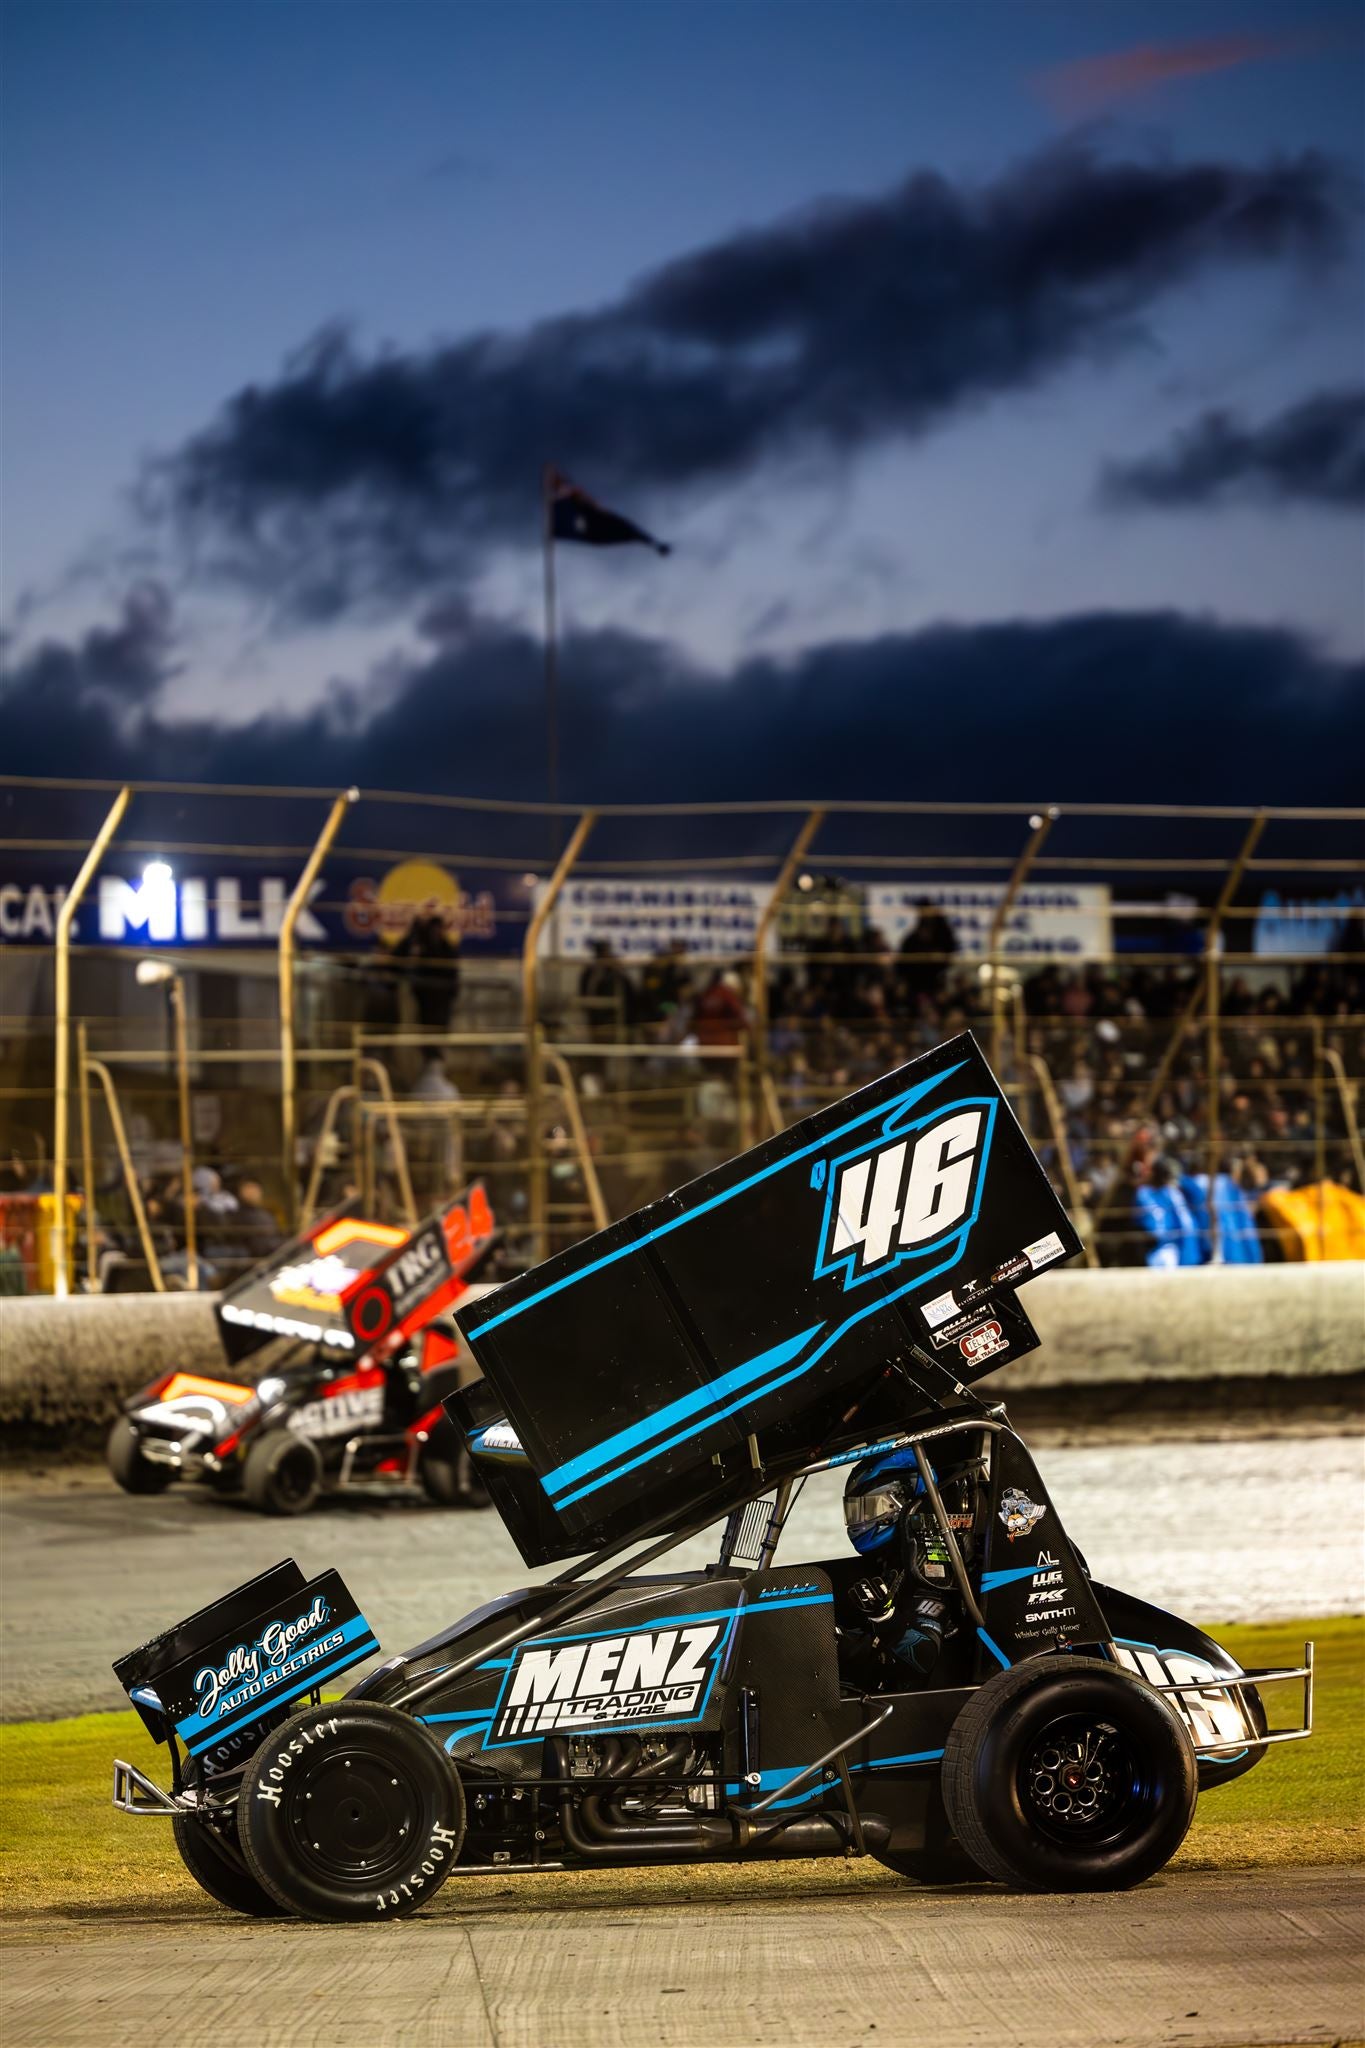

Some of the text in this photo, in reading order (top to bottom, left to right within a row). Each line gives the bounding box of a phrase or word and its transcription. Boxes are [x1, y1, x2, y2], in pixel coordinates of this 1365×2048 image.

[100, 874, 327, 940] MILK
[831, 1112, 982, 1267] 46
[944, 1312, 989, 1338] PERFORMAN
[968, 1340, 1009, 1366] OVAL TRACK PRO
[196, 1598, 329, 1717] Jolly Good
[218, 1631, 345, 1716] AUTO ELECTRICS
[507, 1625, 720, 1707] MENZ
[566, 1685, 695, 1715] TRADING
[592, 1703, 668, 1721] & HIRE
[256, 1718, 338, 1809] Hoosier
[376, 1820, 456, 1911] Hoosier
